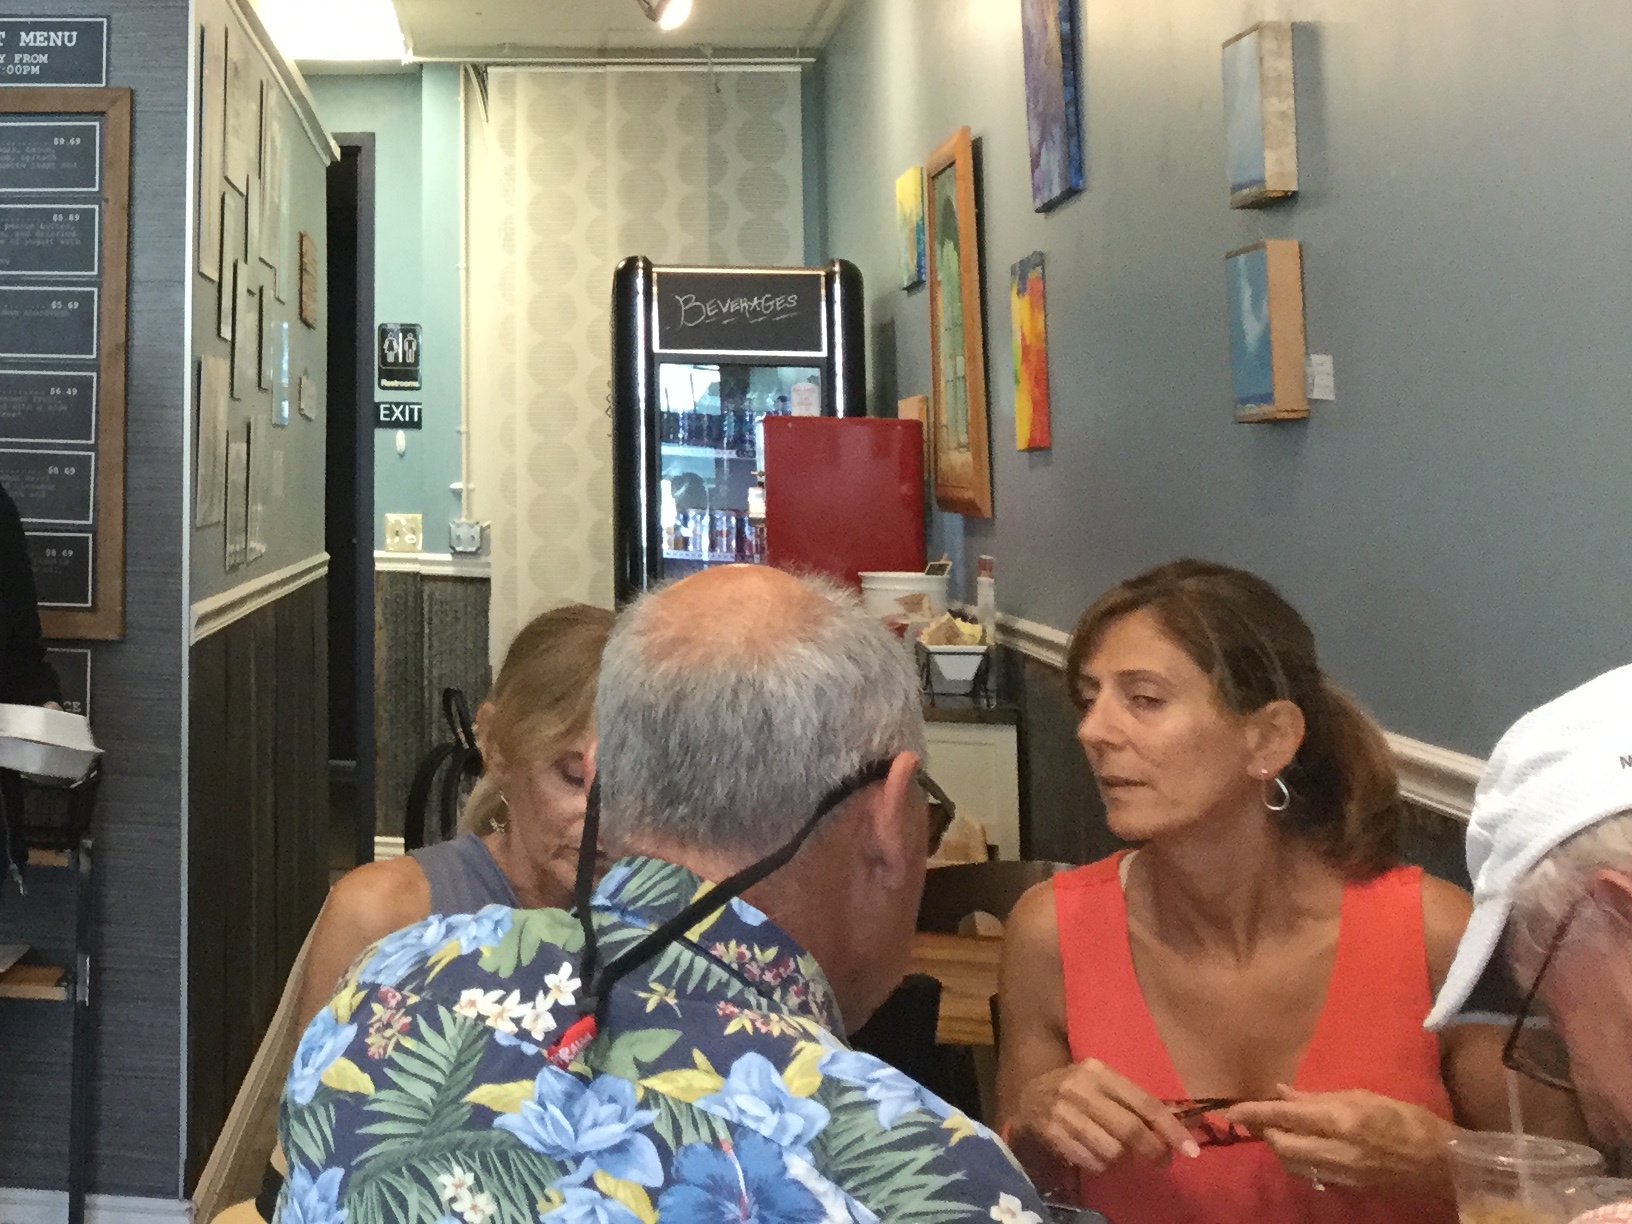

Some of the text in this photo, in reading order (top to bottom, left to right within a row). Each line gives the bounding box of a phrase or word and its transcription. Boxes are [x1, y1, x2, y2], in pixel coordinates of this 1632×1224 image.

[18, 30, 78, 47] MENU
[14, 53, 49, 64] FROM
[674, 293, 798, 327] BEVERAGES
[380, 378, 421, 389] Restrooms
[379, 404, 423, 422] EXIT
